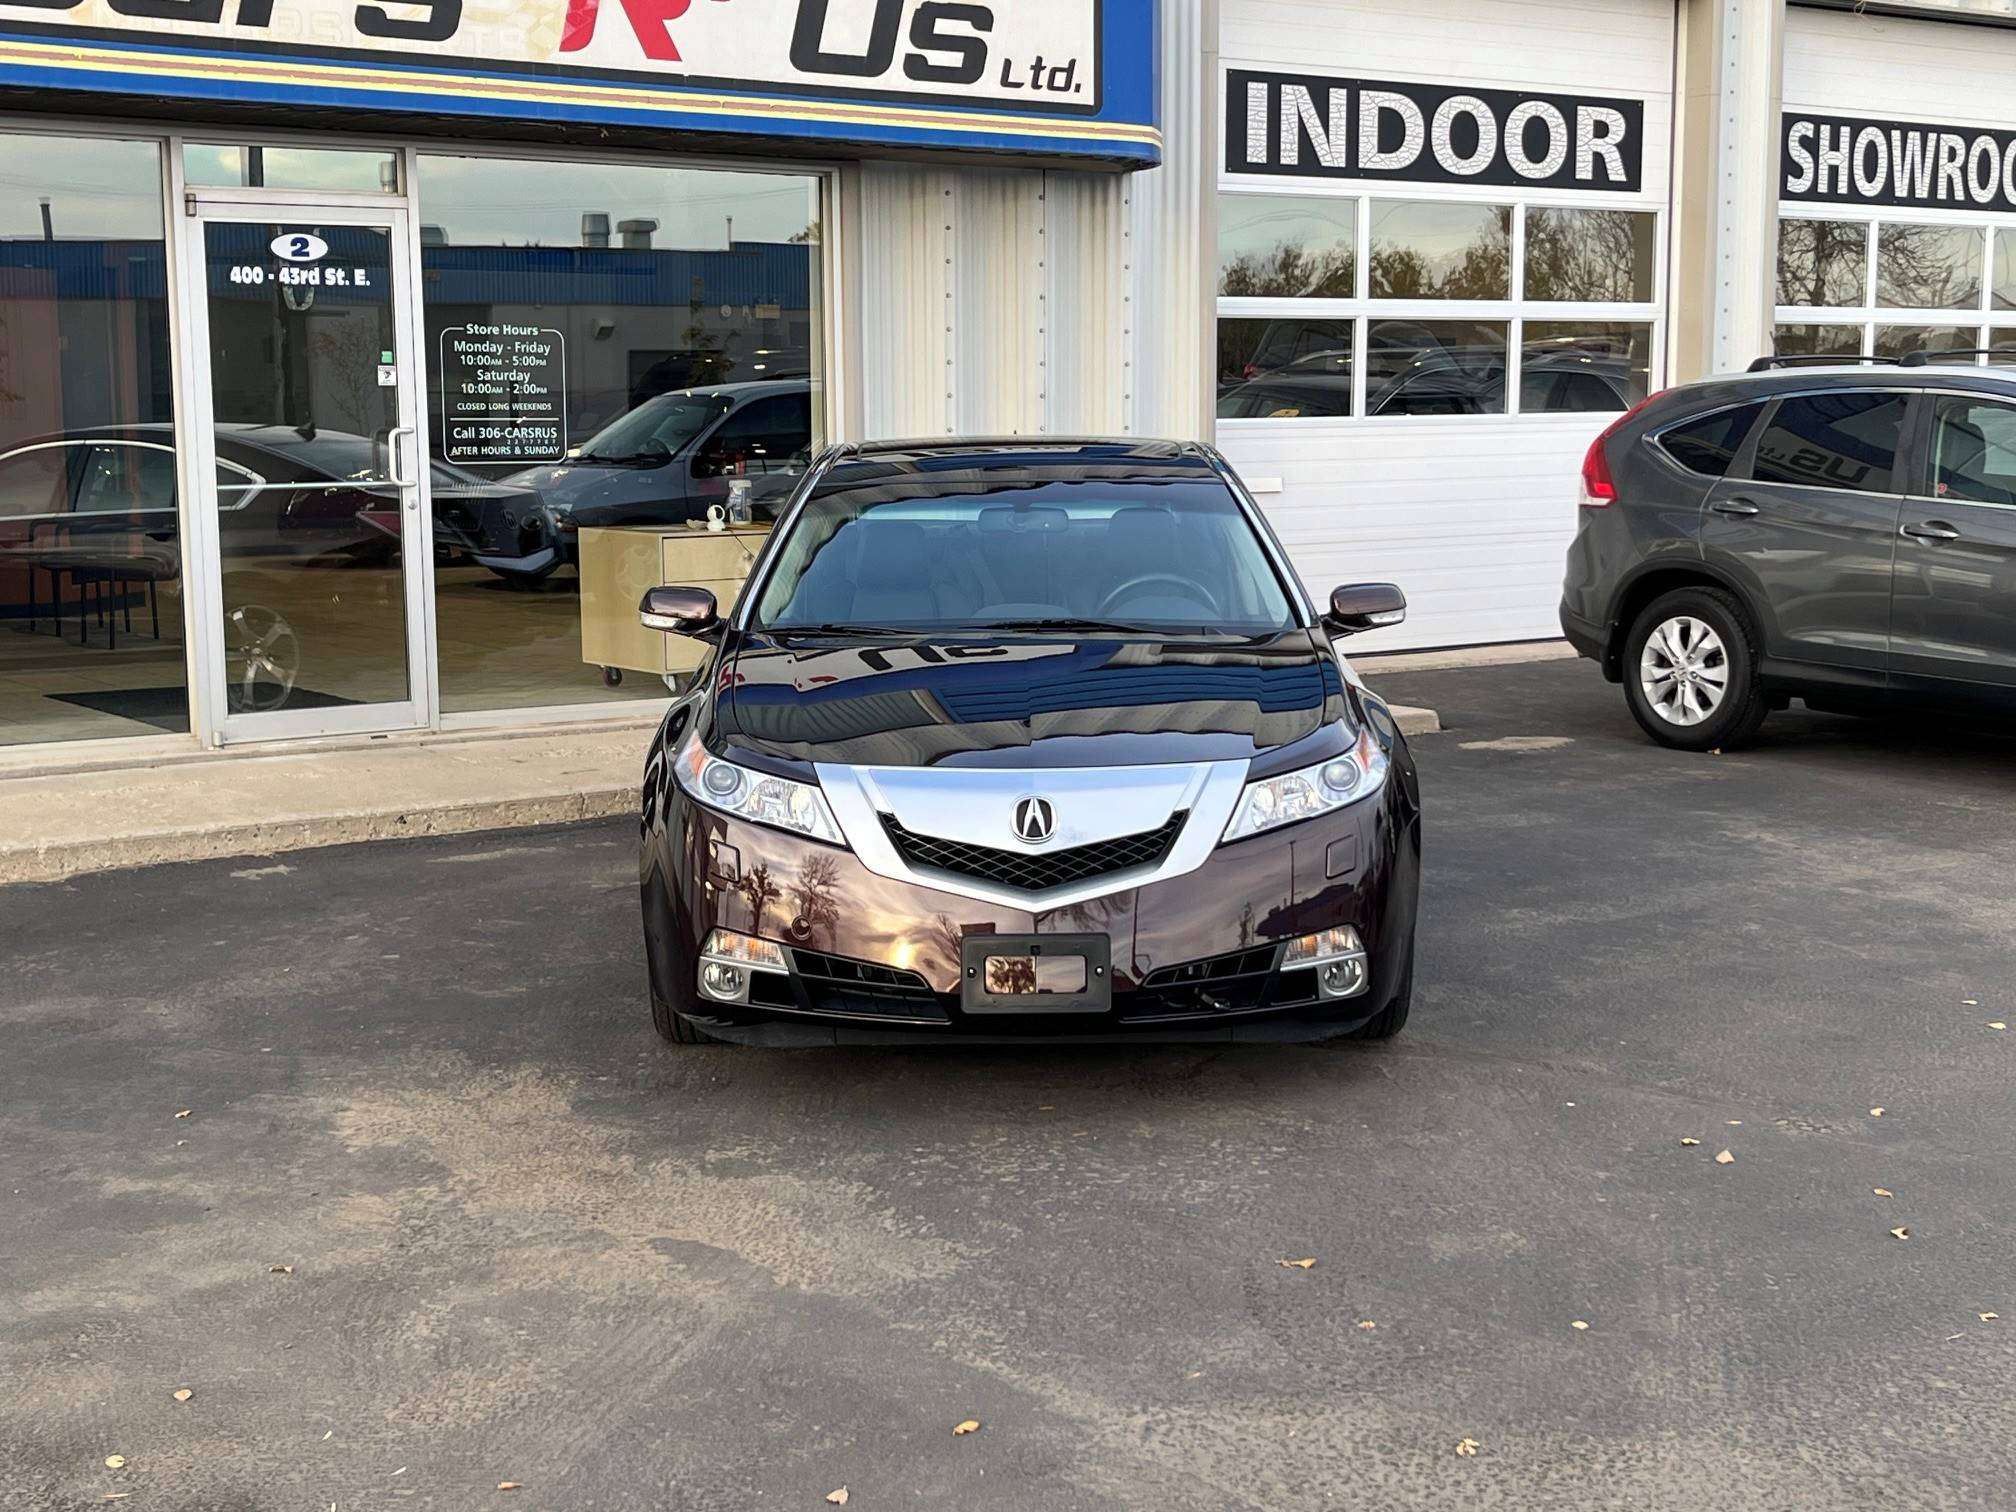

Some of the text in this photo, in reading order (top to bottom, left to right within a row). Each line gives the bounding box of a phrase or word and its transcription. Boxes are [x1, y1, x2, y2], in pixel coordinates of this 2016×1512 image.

[1000, 55, 1081, 93] Ltd.
[1246, 81, 1628, 182] INDOOR
[290, 237, 310, 257] 2
[230, 266, 264, 285] 400
[278, 267, 320, 285] 43rd
[325, 268, 350, 286] St.
[354, 268, 371, 286] E.
[466, 323, 539, 336] Store Hours
[454, 340, 504, 355] Monday
[515, 341, 551, 356] Friday
[460, 355, 502, 366] 10:00AM
[512, 356, 547, 366] 5:00PM
[477, 369, 531, 383] Saturday
[461, 383, 503, 394] 10:00AM
[513, 383, 548, 394] 2:00PM
[488, 403, 510, 411] LONG
[512, 403, 552, 411] WEEKENDS
[453, 427, 558, 439] Call 306-CARSRUS
[451, 446, 560, 455] AFTER HOURS & SUNDAY
